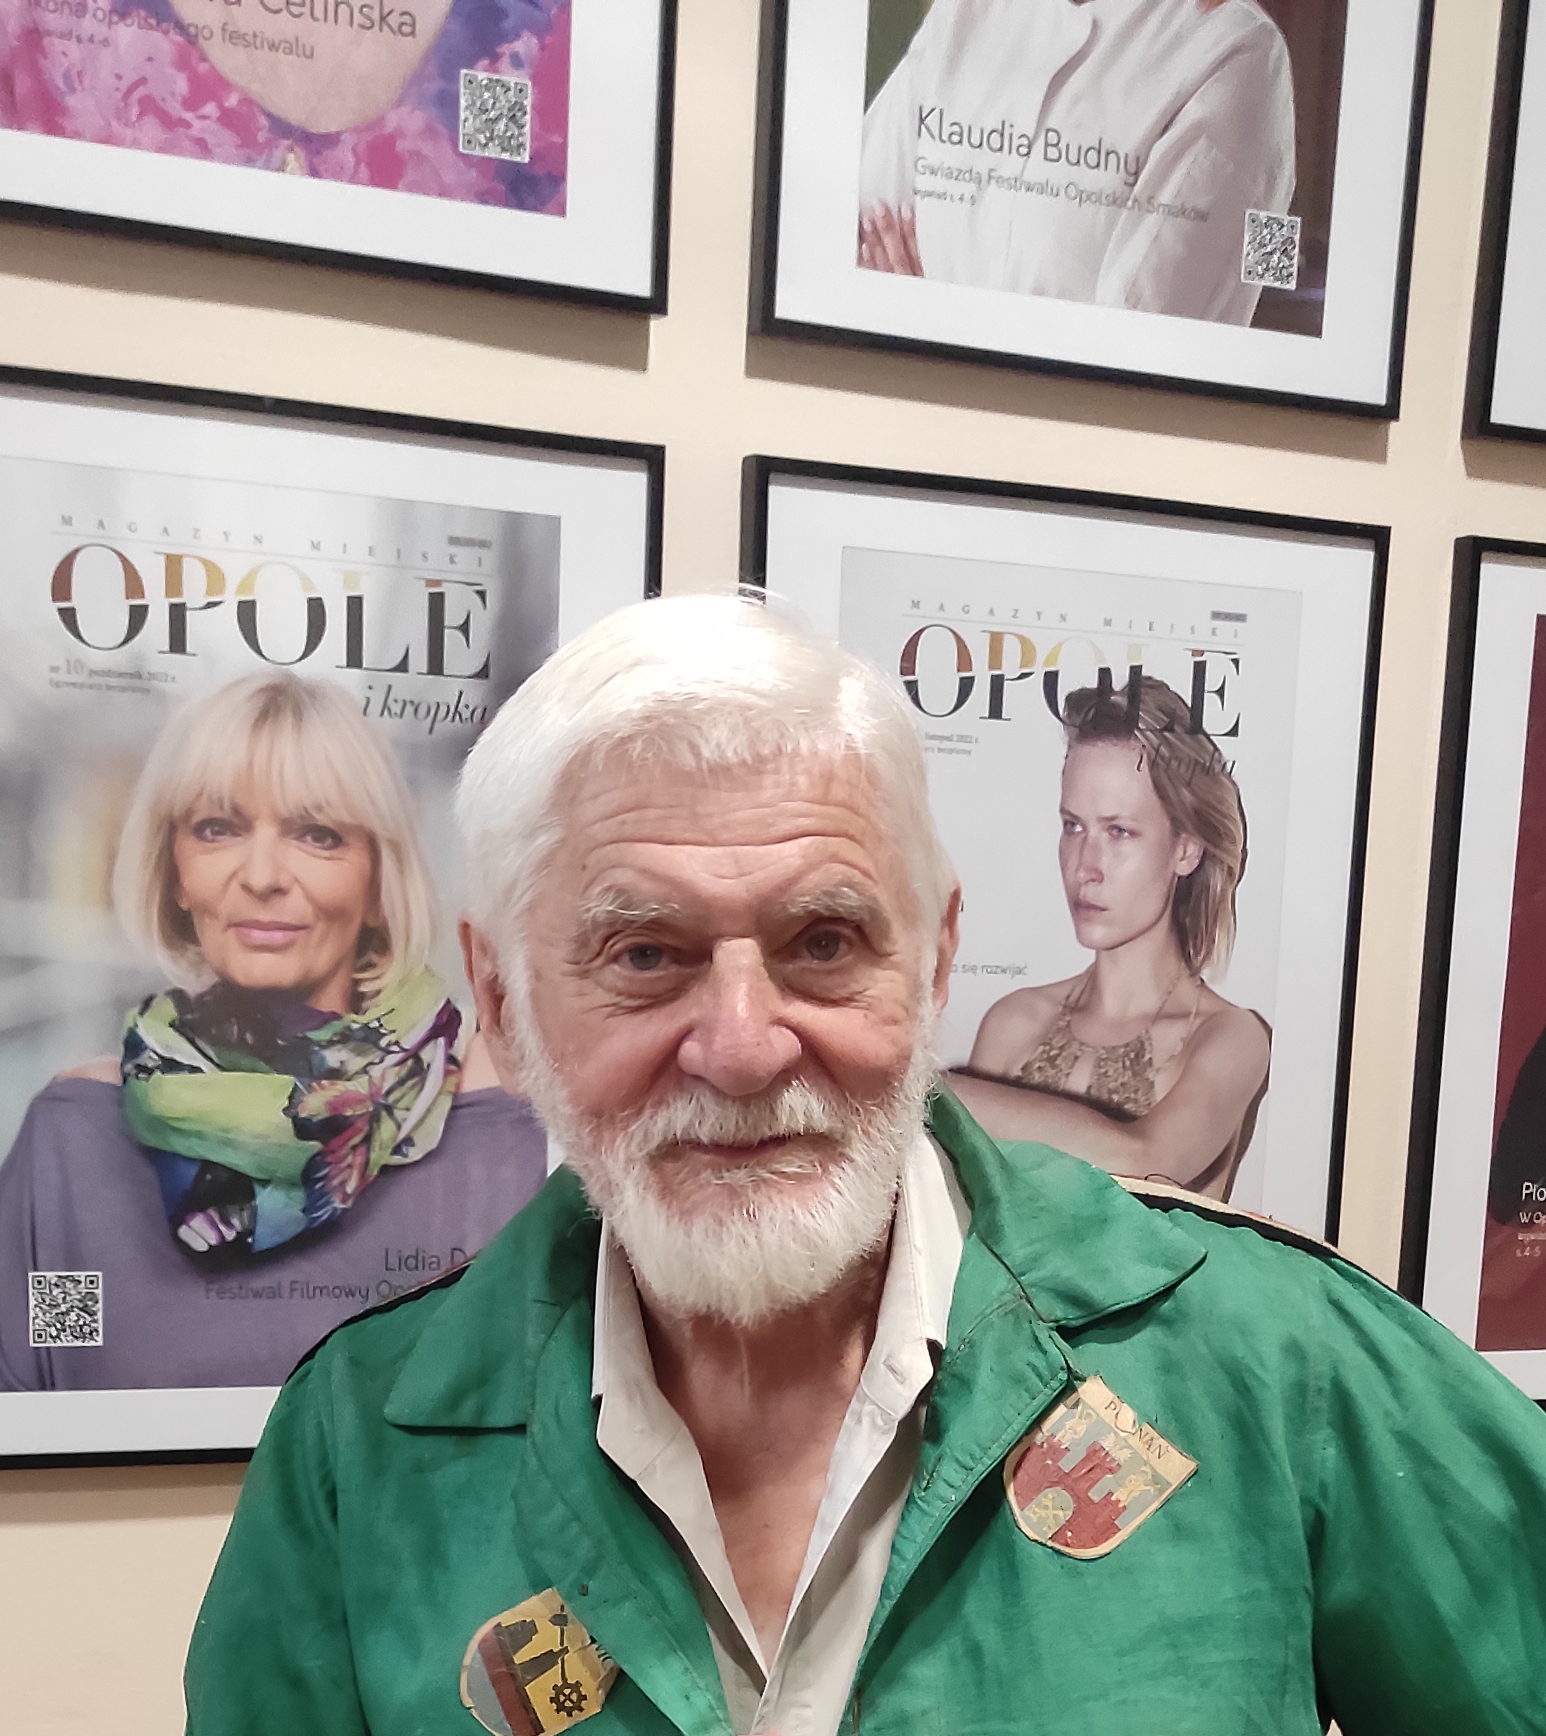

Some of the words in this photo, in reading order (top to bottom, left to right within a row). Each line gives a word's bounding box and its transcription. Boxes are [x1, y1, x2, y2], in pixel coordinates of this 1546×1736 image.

[220, 22, 315, 60] festiwalu
[916, 104, 1033, 159] Klaudia
[1042, 127, 1141, 188] Budny
[60, 513, 264, 546] MAGAZYN
[50, 542, 492, 681] OPOLE
[910, 598, 1070, 625] MAGAZYN
[898, 623, 1242, 739] OPOLE
[362, 686, 374, 718] i
[379, 684, 489, 736] kropka
[1519, 1211, 1532, 1224] W
[384, 1247, 442, 1273] Lidia
[289, 1280, 370, 1304] Filmowy
